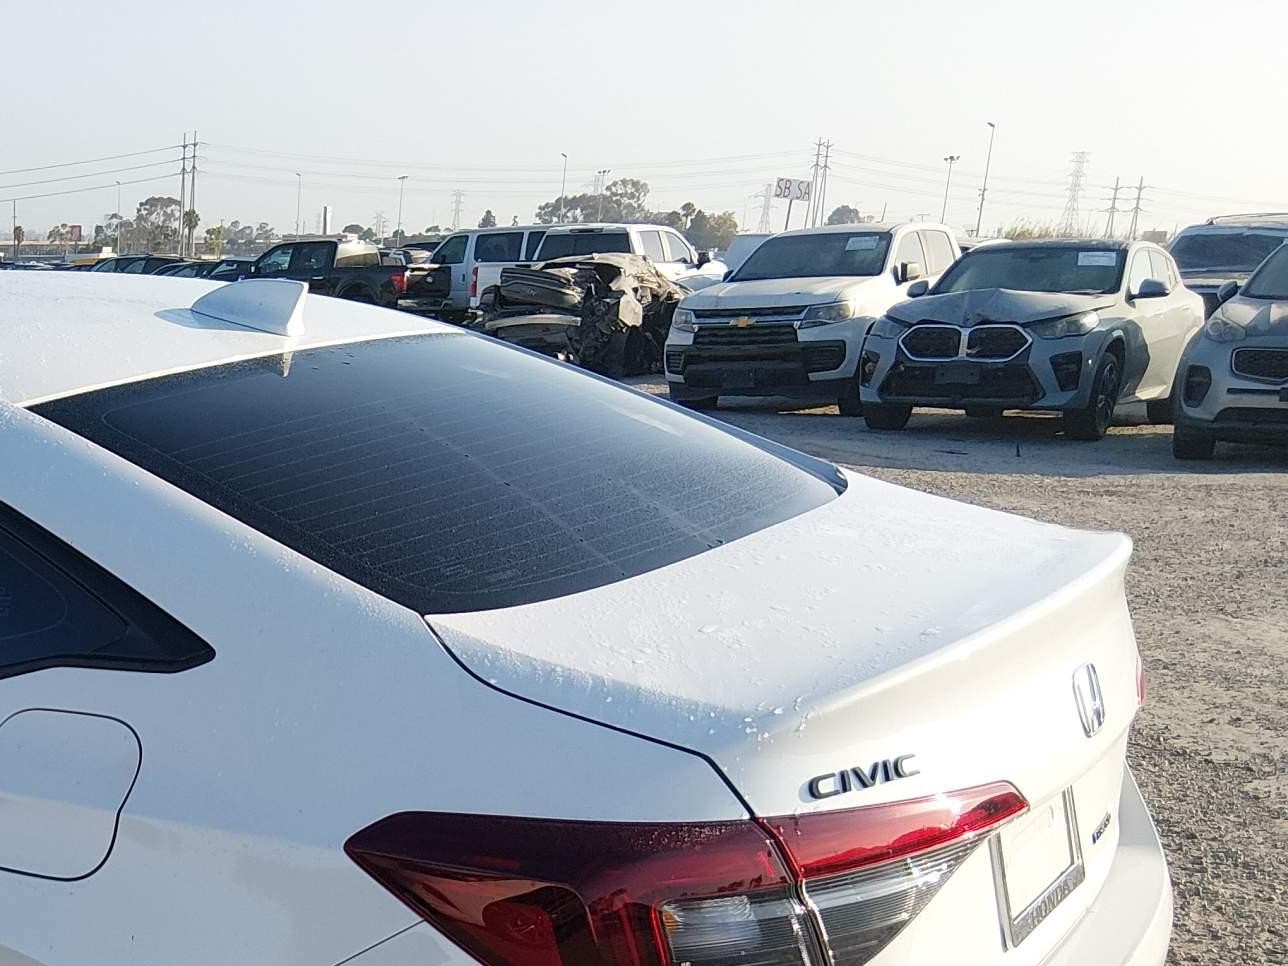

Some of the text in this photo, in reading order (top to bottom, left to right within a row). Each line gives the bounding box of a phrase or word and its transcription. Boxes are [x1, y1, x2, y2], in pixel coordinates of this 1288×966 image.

[775, 178, 810, 200] SB SA
[807, 753, 920, 799] CIVIC
[1029, 876, 1075, 929] HONDA
